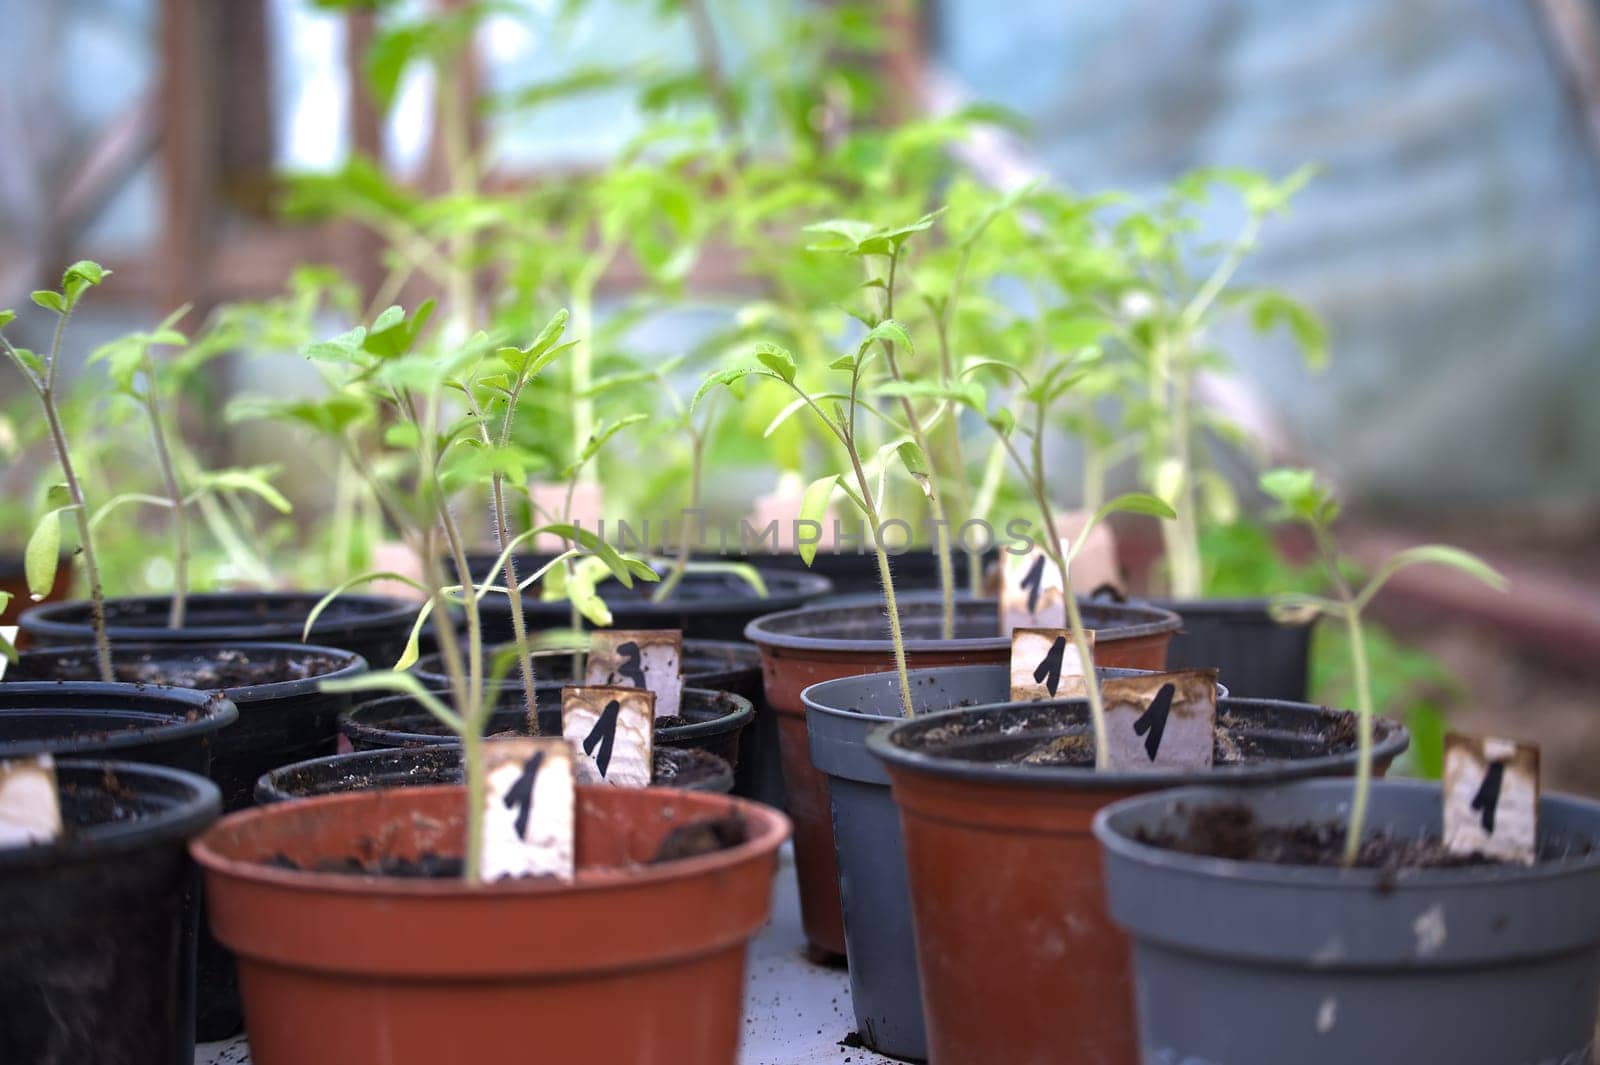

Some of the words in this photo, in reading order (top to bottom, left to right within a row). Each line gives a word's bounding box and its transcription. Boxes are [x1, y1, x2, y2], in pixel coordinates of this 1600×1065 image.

[1020, 555, 1045, 615] 1
[1034, 636, 1065, 697] 1
[583, 700, 620, 778] 1
[1133, 683, 1175, 762] 1
[503, 750, 545, 841] 1
[1471, 761, 1504, 838] 1
